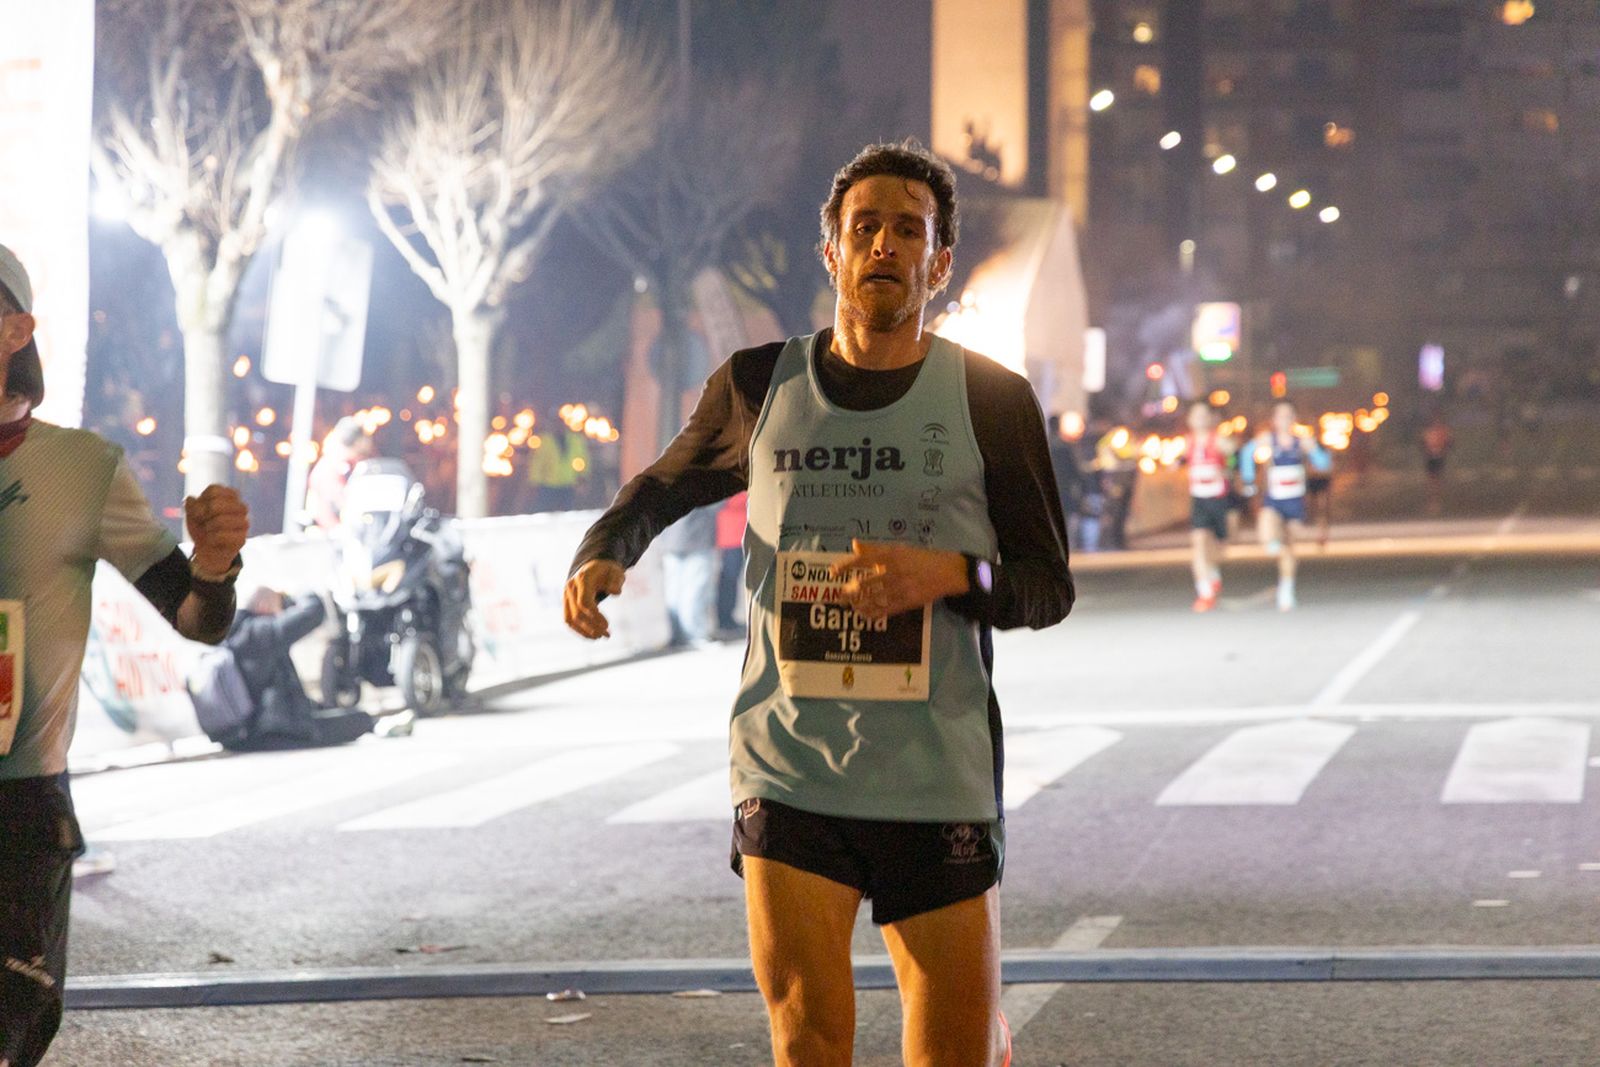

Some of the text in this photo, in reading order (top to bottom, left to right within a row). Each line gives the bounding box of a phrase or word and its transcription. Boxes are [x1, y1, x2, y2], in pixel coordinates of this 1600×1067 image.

[773, 437, 906, 480] nerja
[792, 484, 885, 499] ATLETISMO
[791, 584, 819, 601] SAN
[838, 630, 861, 652] 15
